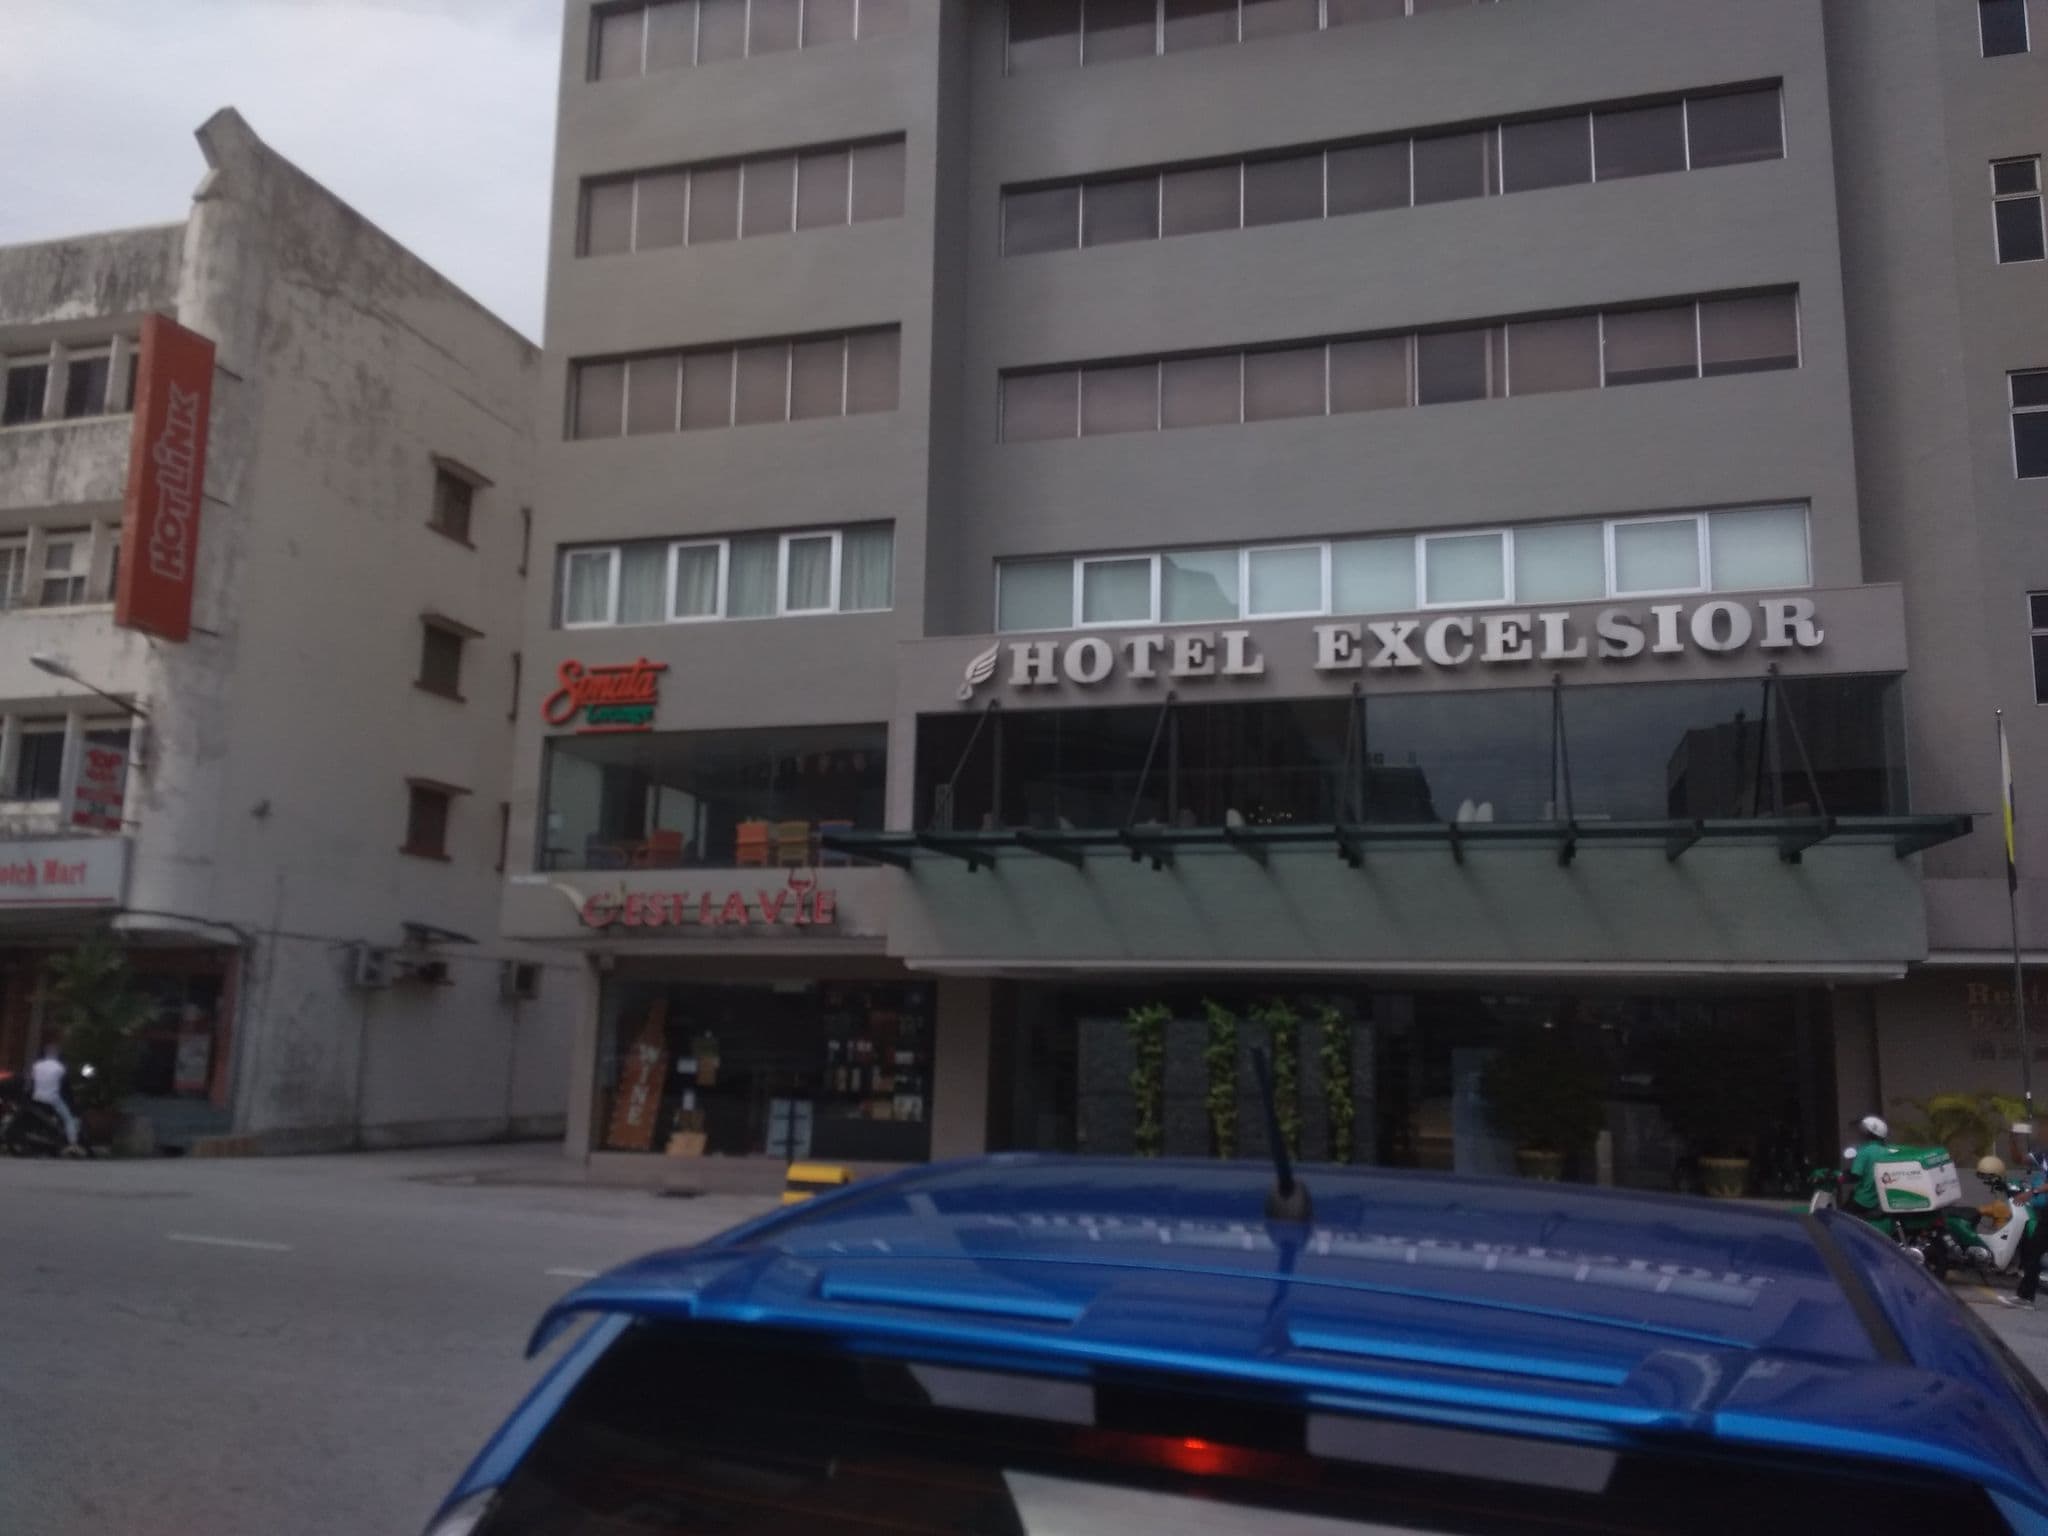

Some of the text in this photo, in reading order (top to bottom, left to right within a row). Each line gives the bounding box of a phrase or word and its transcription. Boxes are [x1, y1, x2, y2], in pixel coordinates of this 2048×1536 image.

[1008, 597, 1825, 686] HOTEL EXCELSIOR
[700, 889, 749, 926] LA
